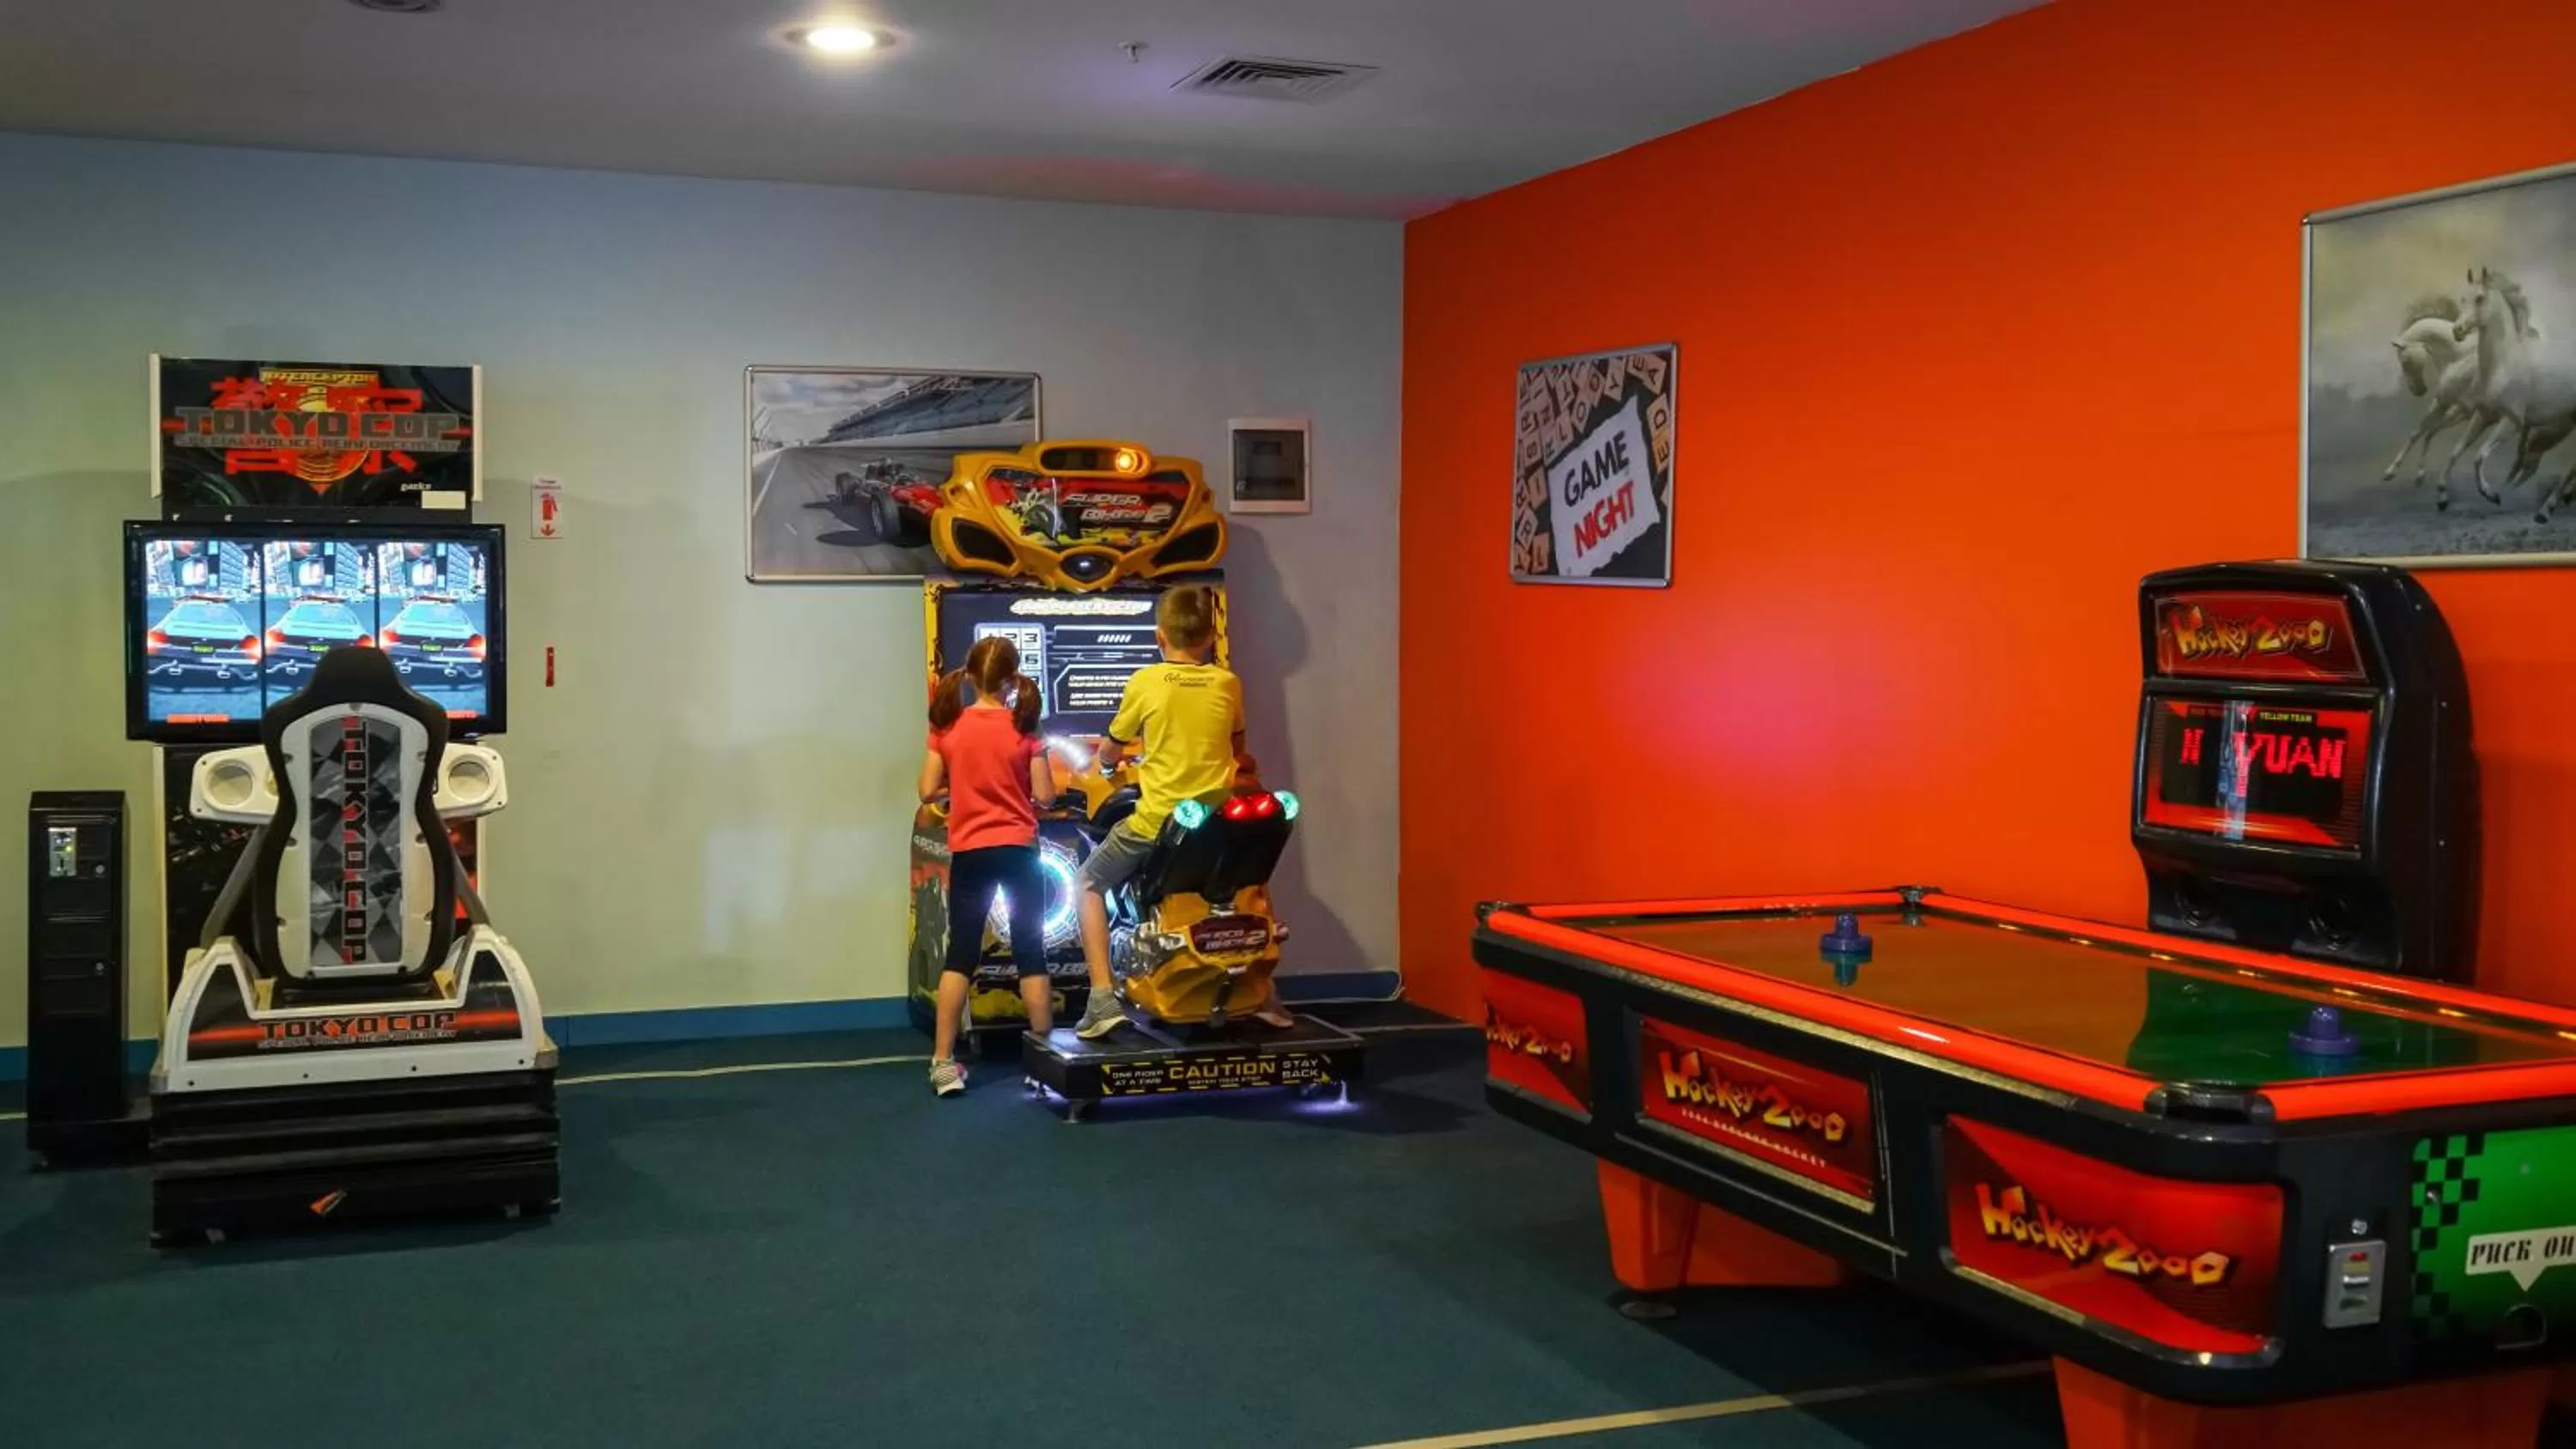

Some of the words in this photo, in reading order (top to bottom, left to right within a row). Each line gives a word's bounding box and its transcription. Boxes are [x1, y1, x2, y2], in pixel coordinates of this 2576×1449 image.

[175, 407, 349, 438] TOKYO
[361, 412, 459, 440] COP
[1564, 430, 1631, 508] GAME
[1573, 481, 1635, 559] NIGHT
[1024, 633, 1038, 643] 3
[2250, 615, 2326, 651] 2000
[1024, 653, 1038, 664] 6
[2259, 712, 2289, 721] YELLOW
[2290, 713, 2312, 723] TEAM
[2233, 731, 2346, 779] YUAN
[343, 717, 368, 870] TOKYO
[343, 881, 368, 963] COP
[262, 1015, 381, 1039] TOKYO
[387, 1011, 455, 1030] COP
[1113, 1070, 1133, 1079] ONE
[1169, 1062, 1276, 1080] CAUTION
[1282, 1058, 1319, 1070] STAY
[1282, 1069, 1320, 1079] BACK
[1659, 1051, 1758, 1119] Hockey
[1759, 1084, 1845, 1141] 2000
[1977, 1183, 2099, 1261] Hockey
[2097, 1225, 2230, 1285] 2000
[2470, 1240, 2532, 1266] PUCK
[2543, 1234, 2576, 1258] OU
